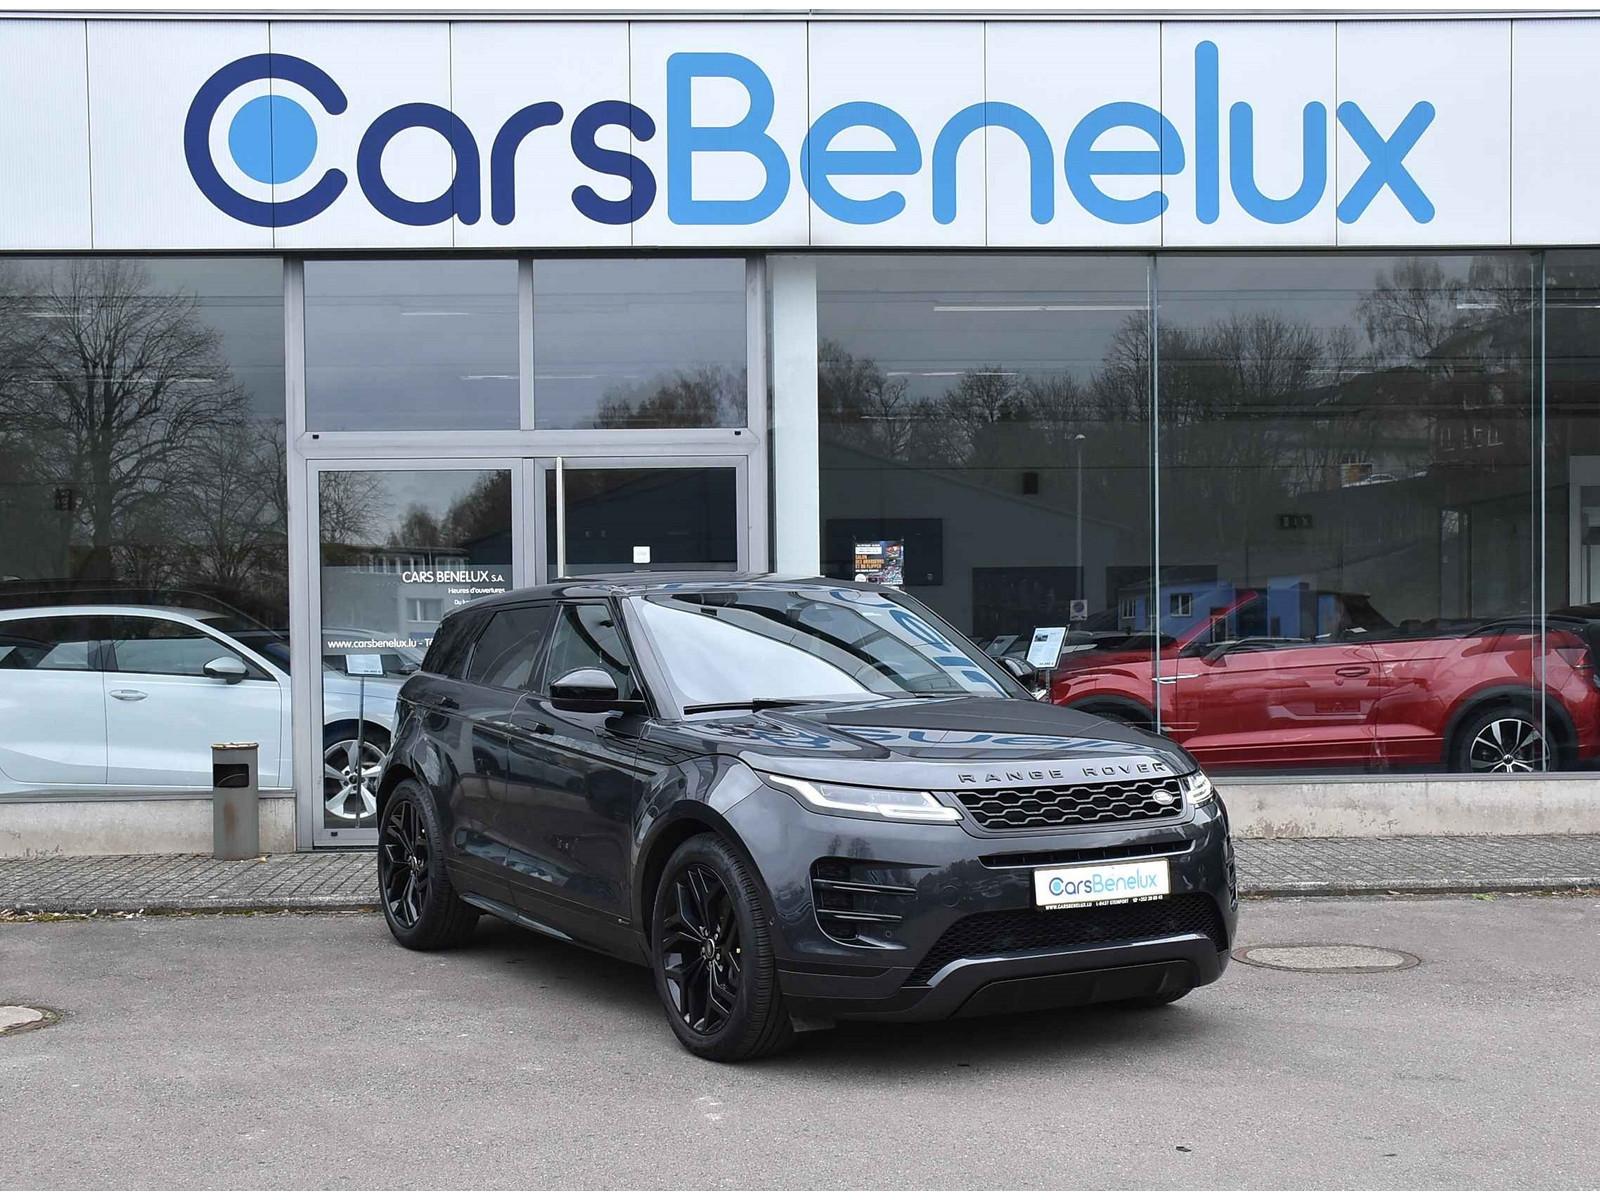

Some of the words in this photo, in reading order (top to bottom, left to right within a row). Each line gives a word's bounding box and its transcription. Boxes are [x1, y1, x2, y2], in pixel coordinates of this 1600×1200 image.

[184, 40, 1435, 226] CarsBenelux
[402, 571, 434, 583] CARS
[436, 570, 489, 583] BENELUX
[327, 638, 417, 649] www.carsbenelux.lu
[958, 768, 1064, 784] RANGE
[1083, 761, 1168, 777] ROVER
[1049, 868, 1158, 896] CarsBenelux
